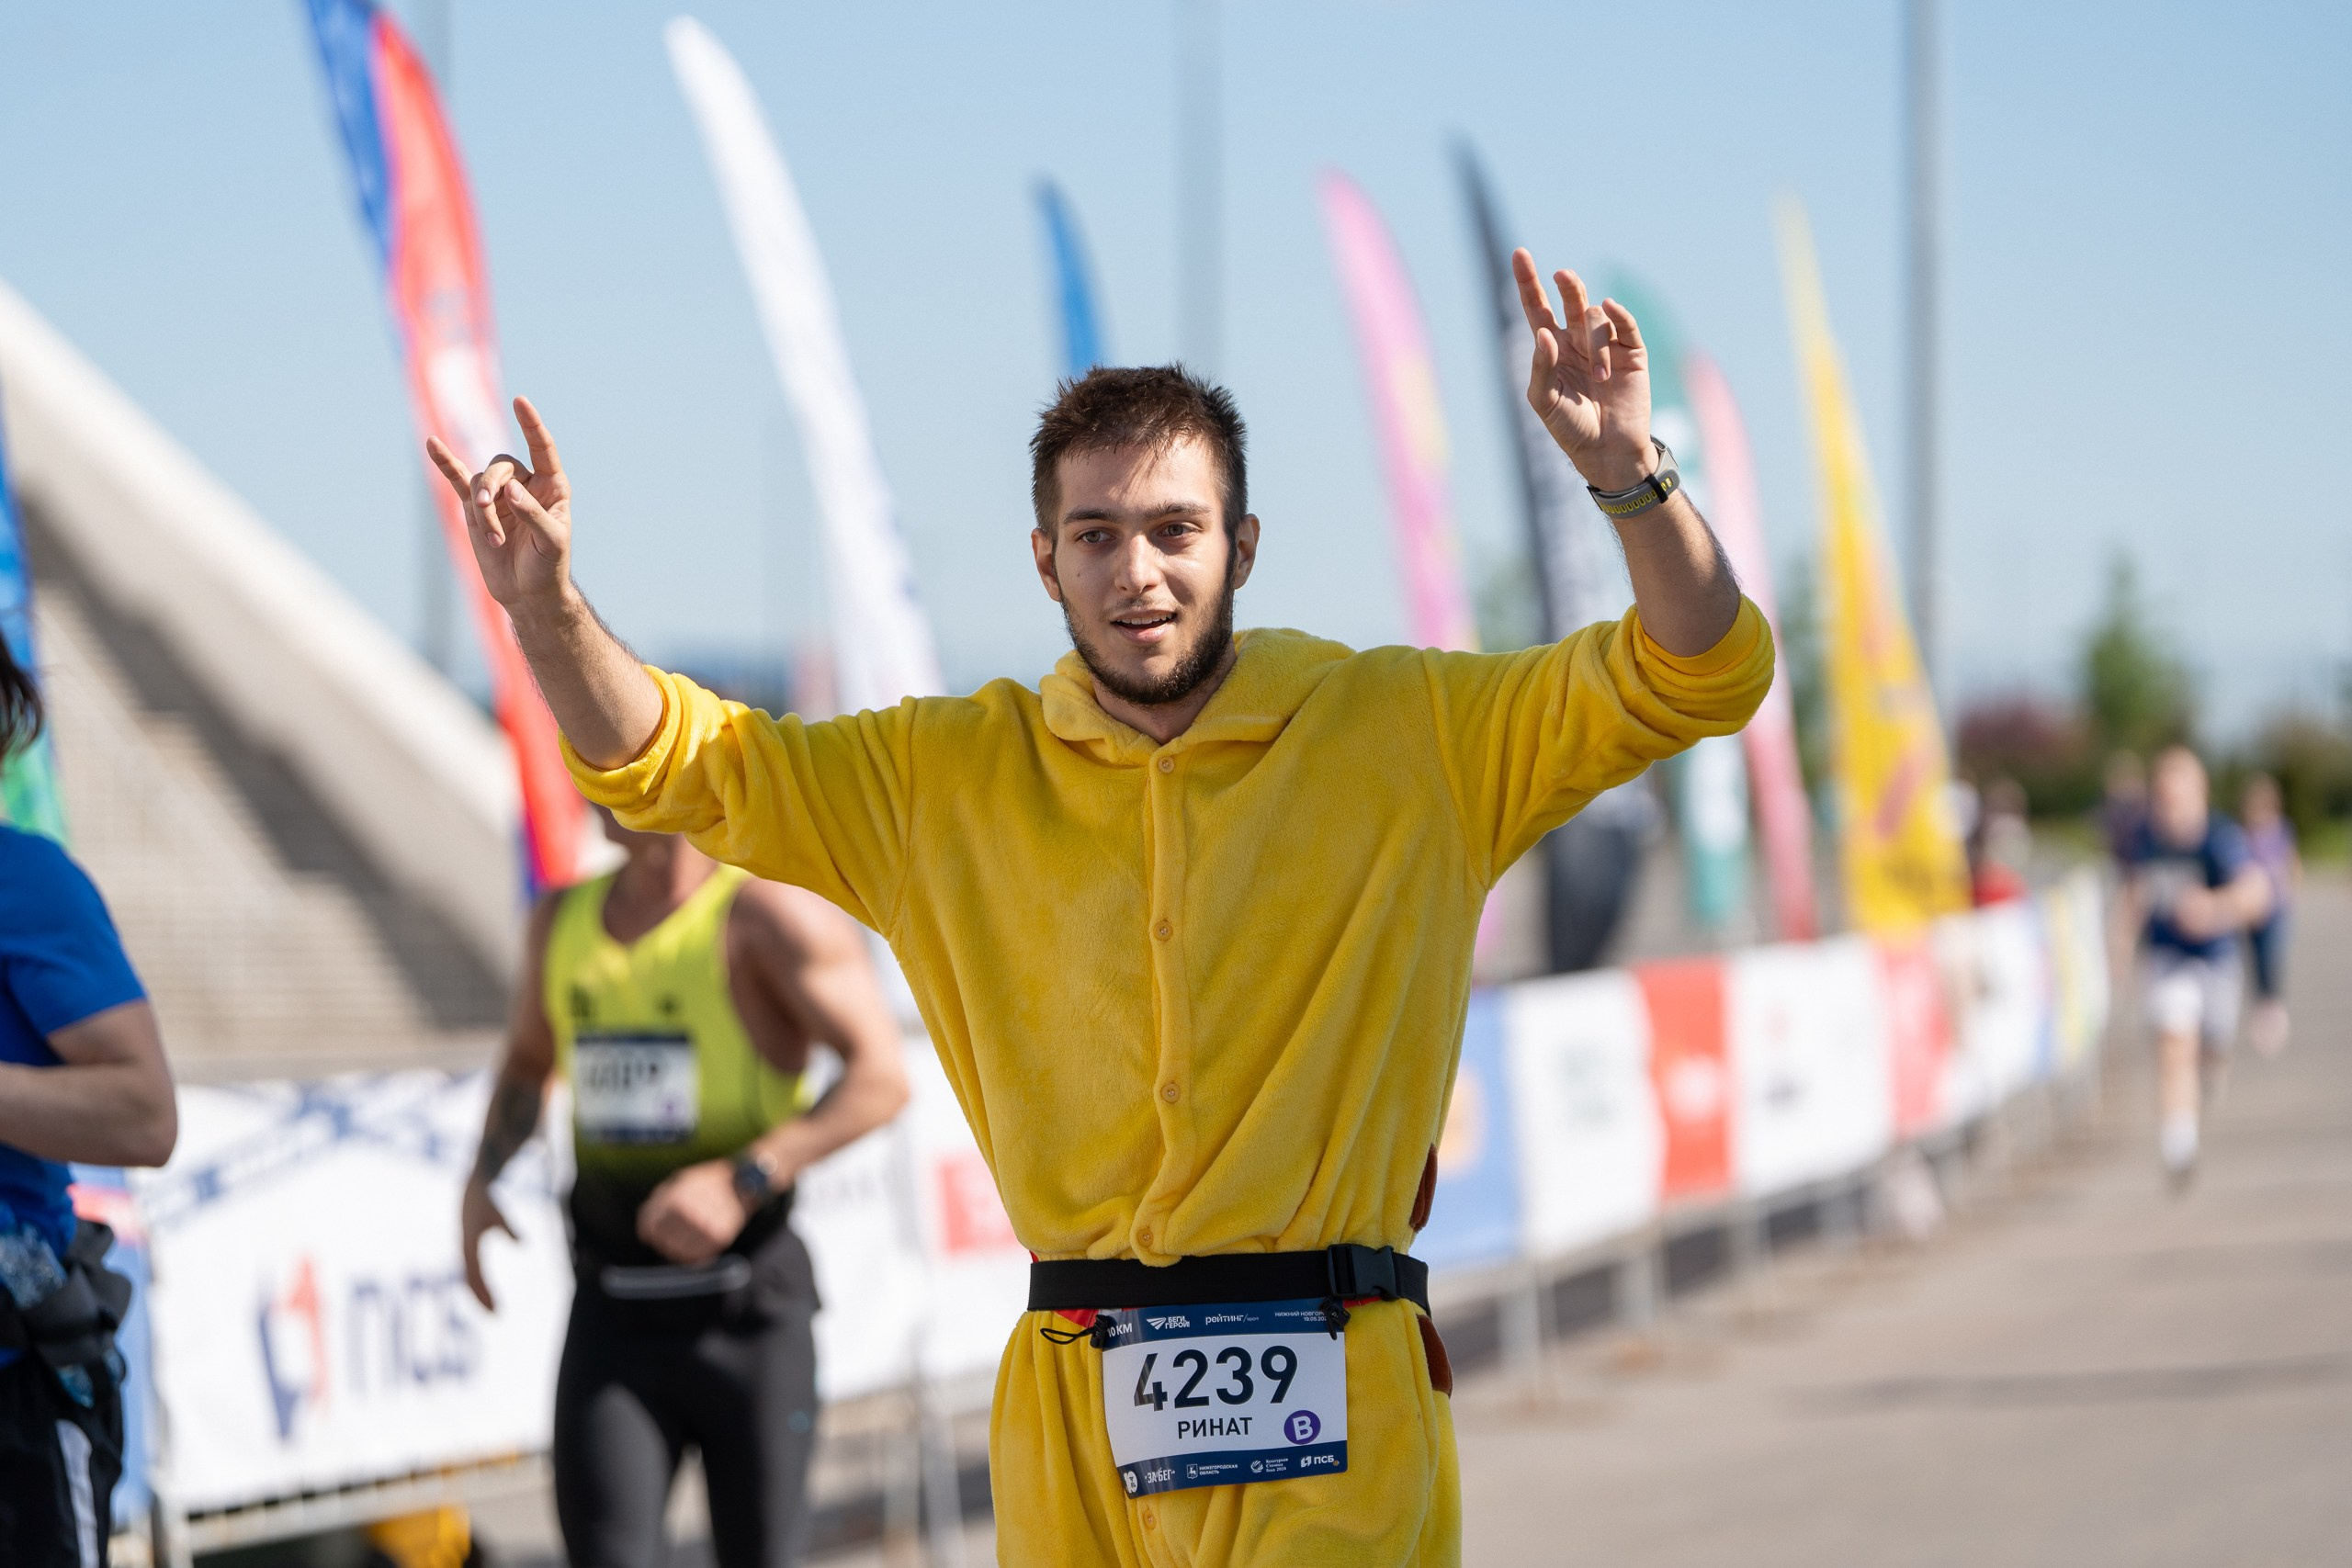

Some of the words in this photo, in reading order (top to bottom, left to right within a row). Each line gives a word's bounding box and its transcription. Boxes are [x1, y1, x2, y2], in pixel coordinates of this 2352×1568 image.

[1134, 1345, 1298, 1412] 4239
[1177, 1417, 1252, 1439] РИНАТ
[1314, 1455, 1335, 1465] ПСБ
